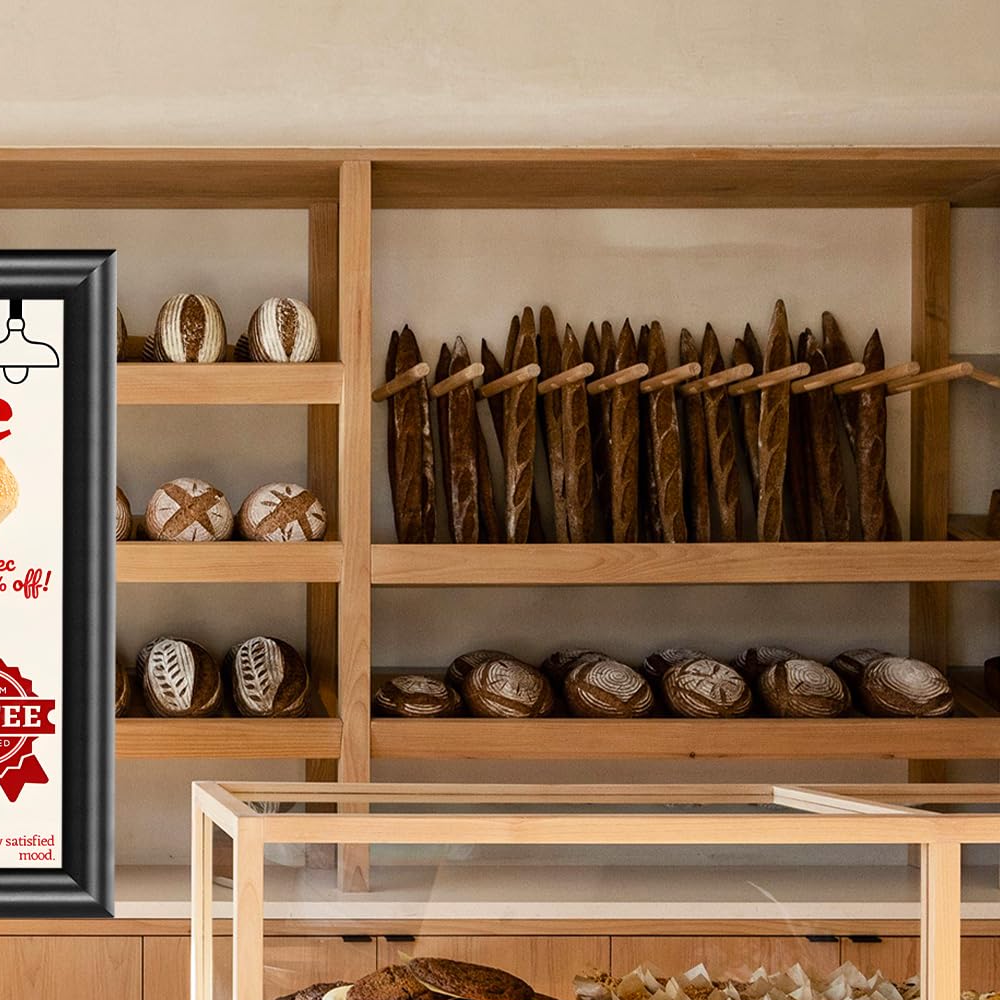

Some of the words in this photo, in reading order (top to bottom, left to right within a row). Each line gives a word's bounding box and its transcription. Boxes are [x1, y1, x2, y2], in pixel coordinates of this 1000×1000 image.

[12, 568, 52, 599] off!
[5, 834, 56, 847] satisfied
[19, 849, 56, 861] mood.
